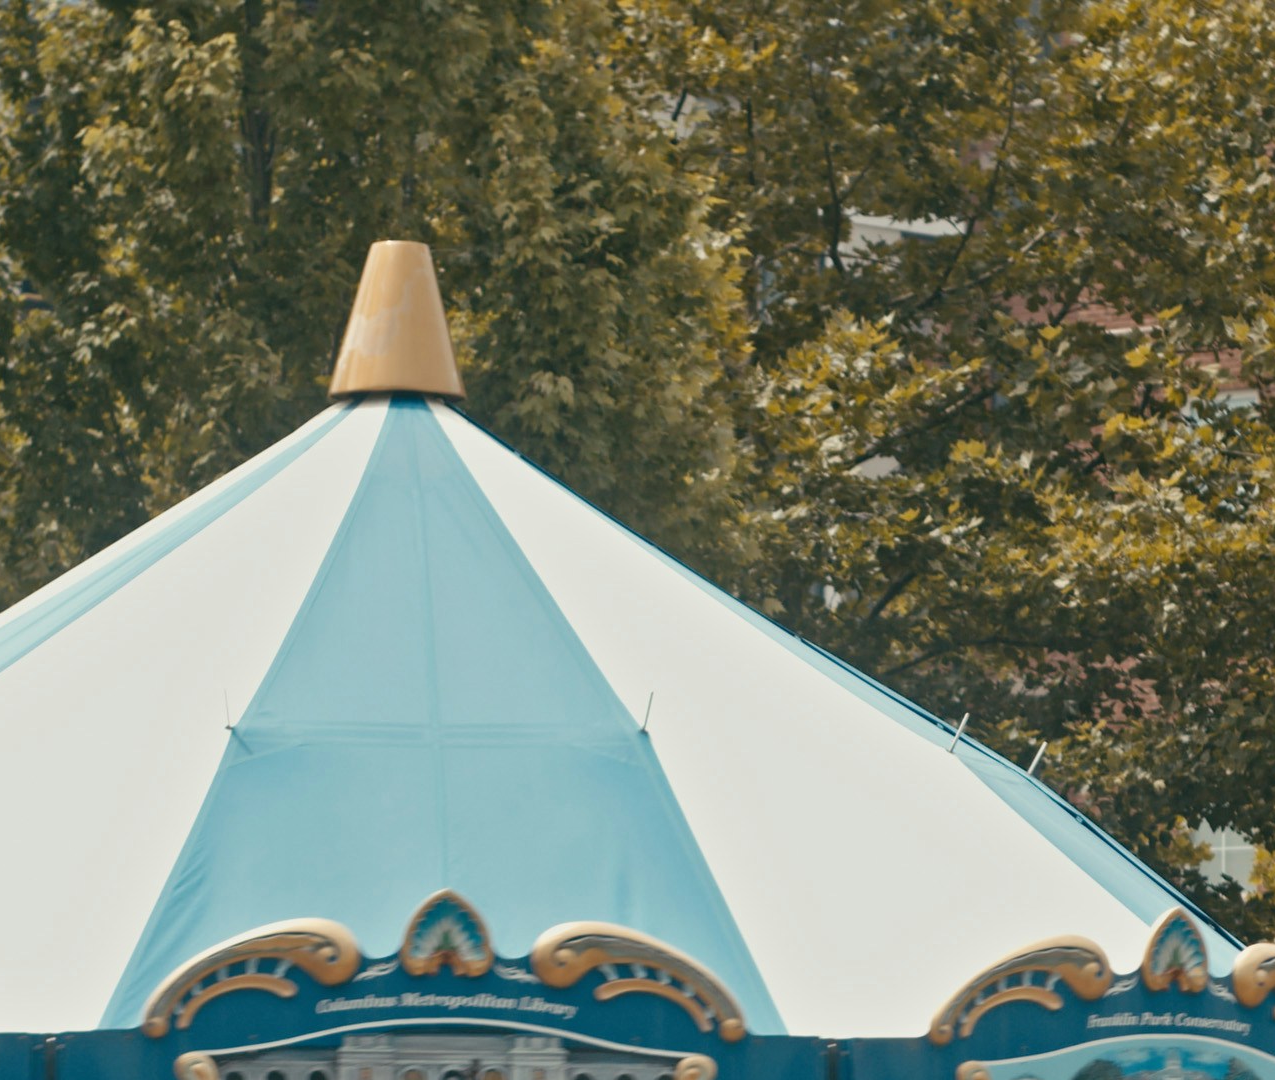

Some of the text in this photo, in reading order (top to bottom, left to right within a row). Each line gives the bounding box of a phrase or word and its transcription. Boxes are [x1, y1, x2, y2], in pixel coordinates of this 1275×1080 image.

[315, 992, 578, 1018] Columbus Metropolitan Library
[1086, 1011, 1252, 1035] Franklin Park Conservatory
